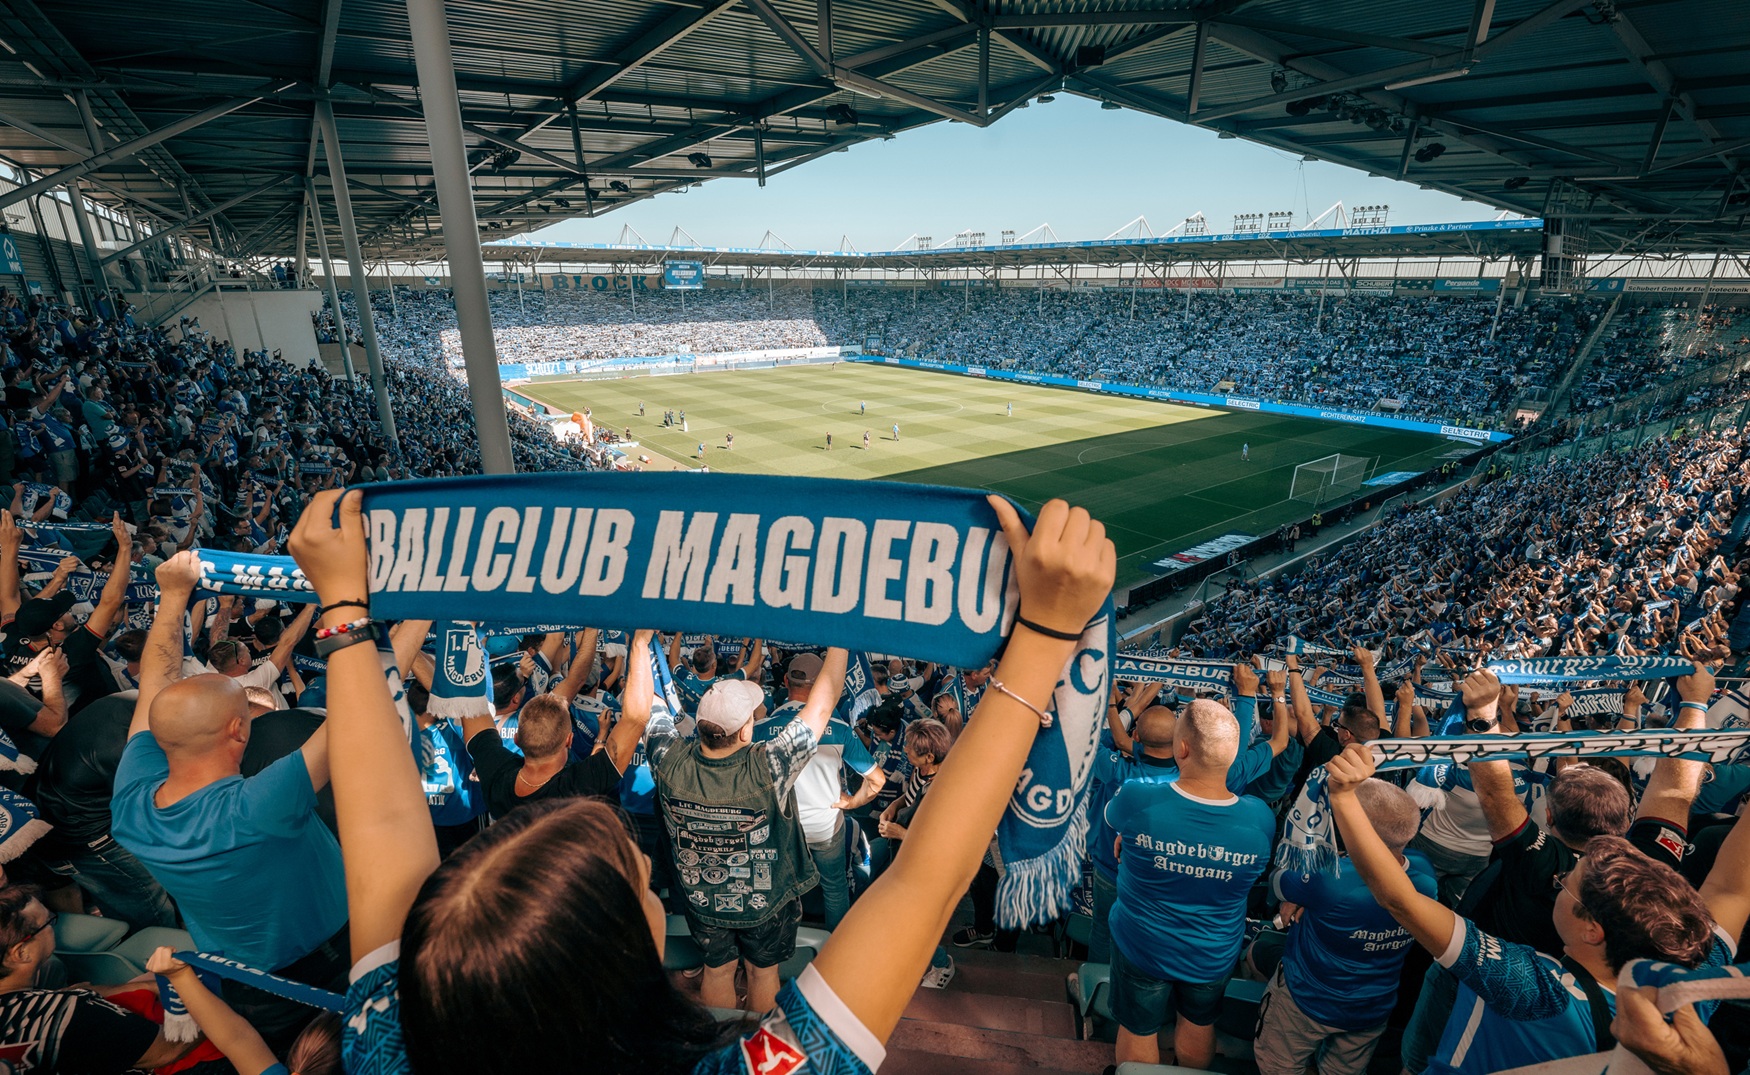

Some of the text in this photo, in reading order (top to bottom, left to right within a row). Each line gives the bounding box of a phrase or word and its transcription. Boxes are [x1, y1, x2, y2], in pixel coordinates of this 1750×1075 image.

[551, 275, 649, 290] BLOCK
[1442, 426, 1490, 439] SELECTRIC
[361, 506, 1020, 638] BALLCLUB MAGDEBU
[1141, 676, 1168, 684] UNS
[694, 804, 742, 815] MAGDEBURG
[1153, 855, 1233, 882] Arroganz
